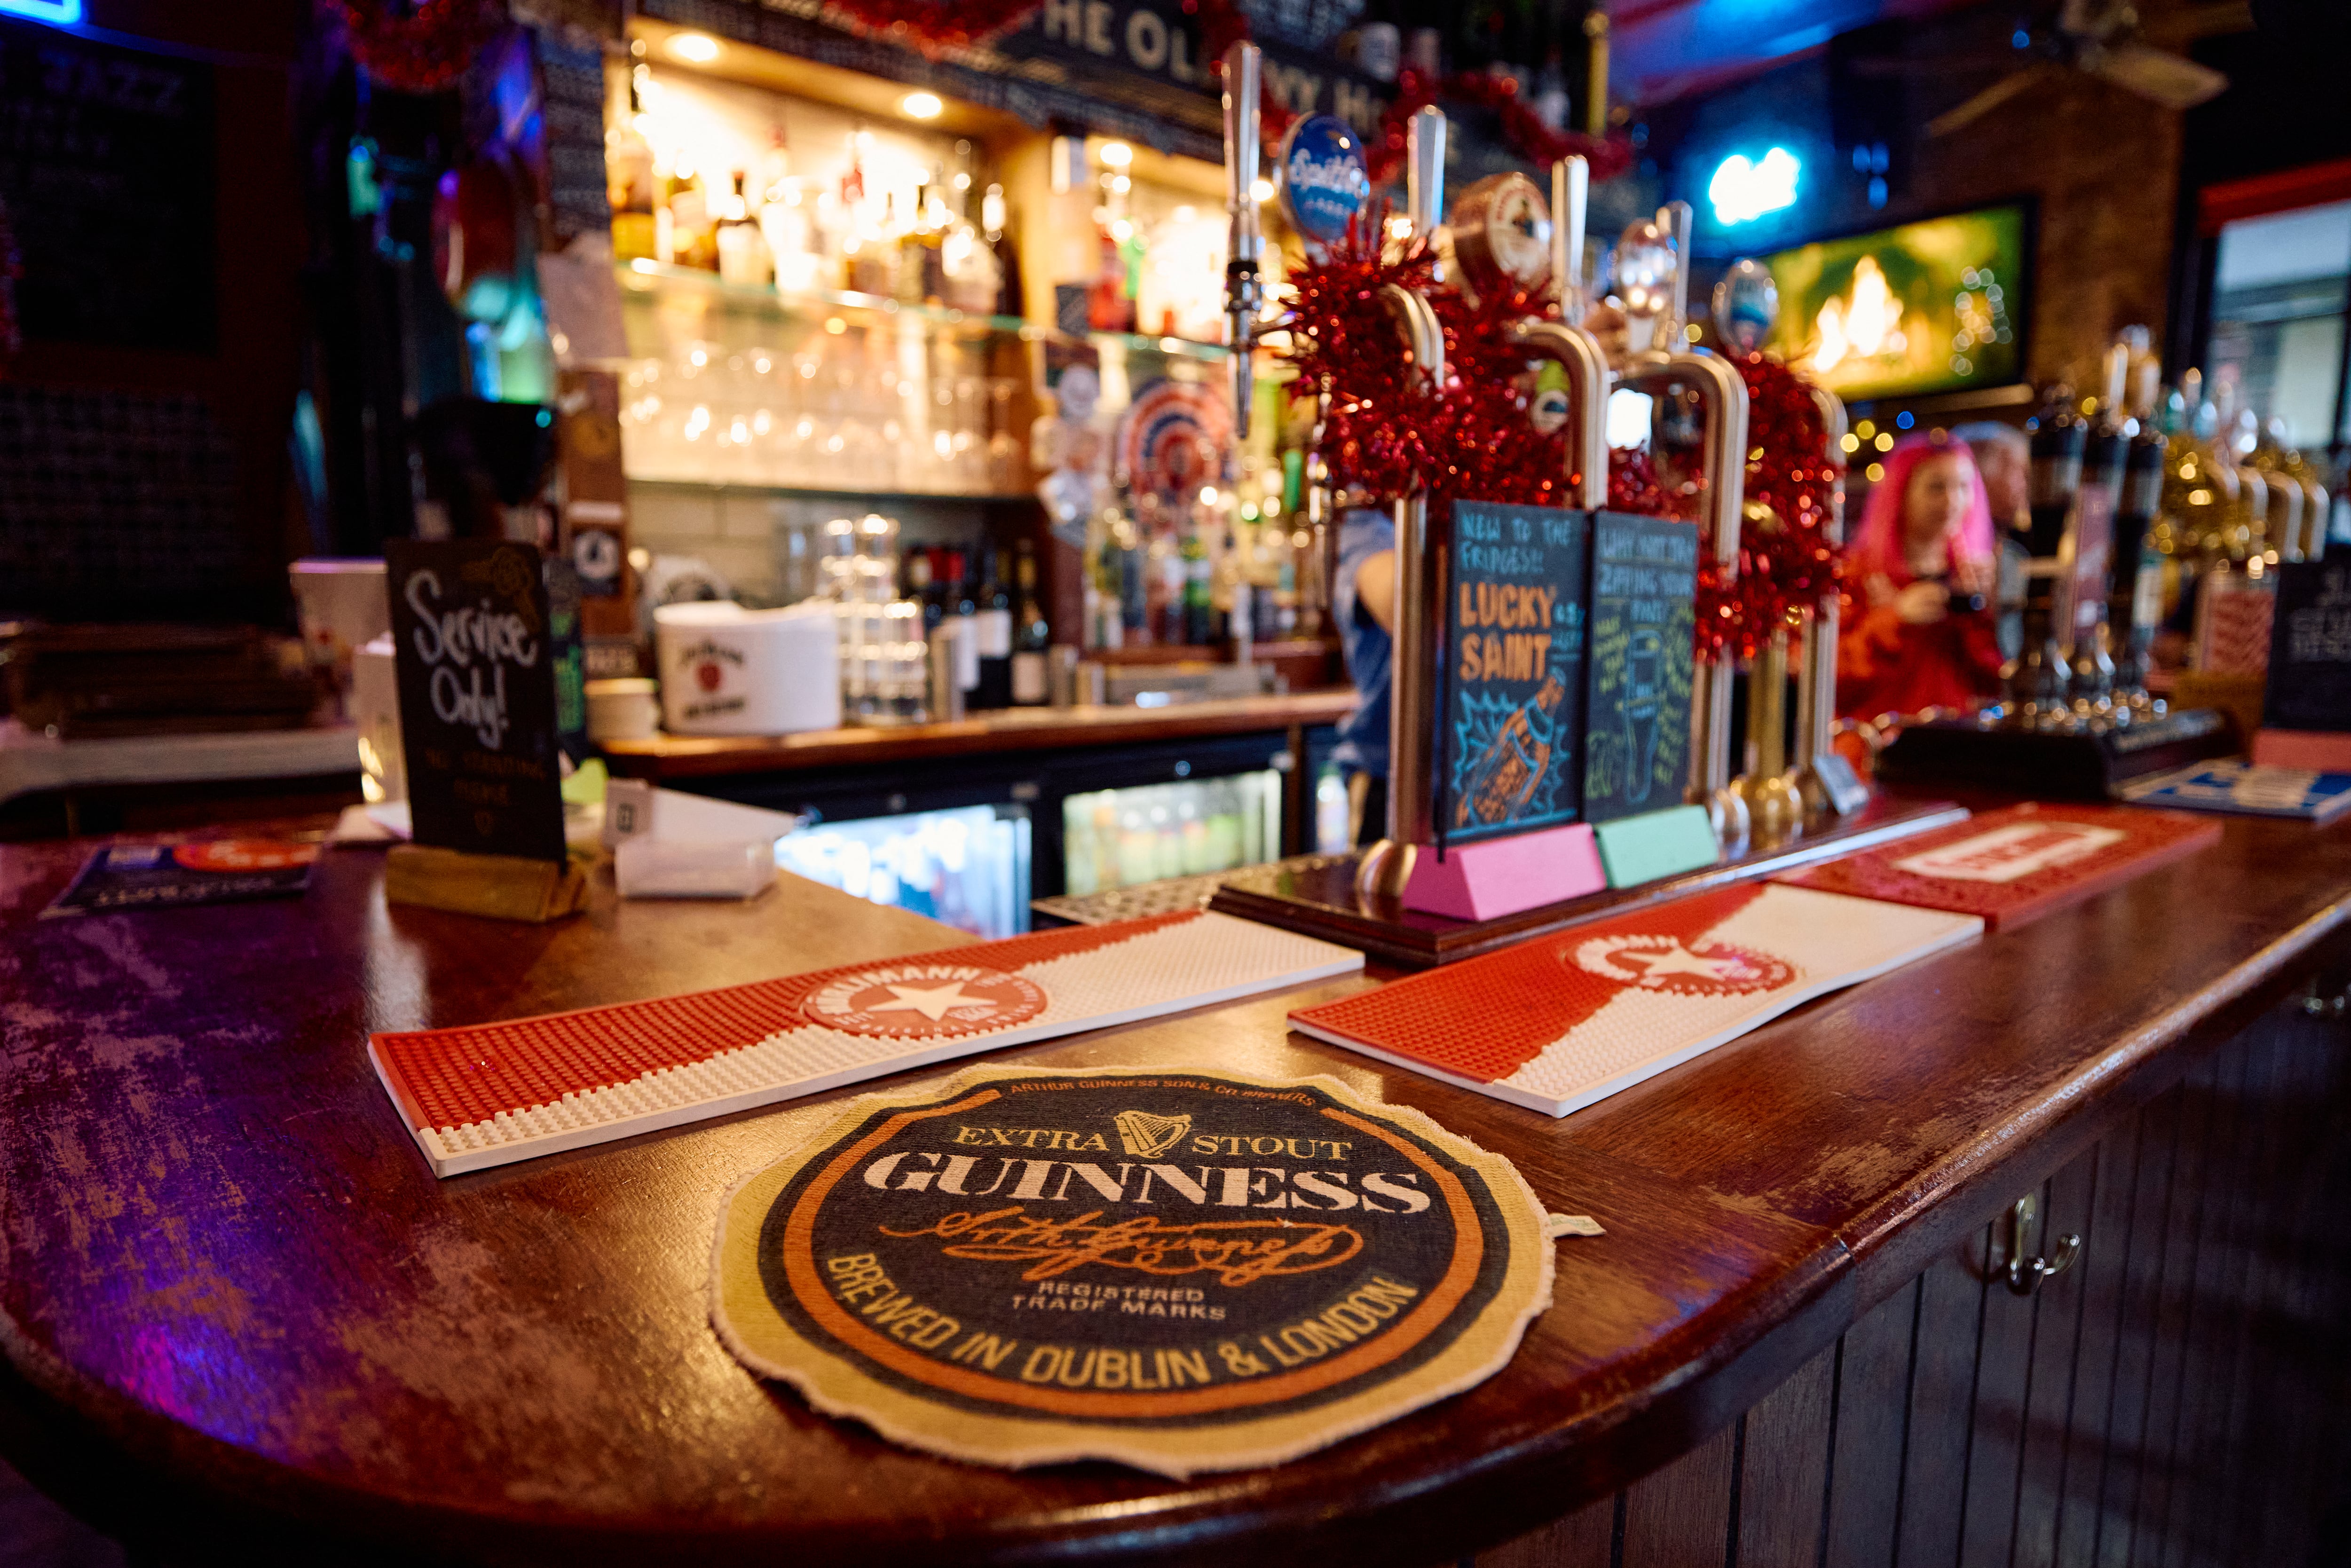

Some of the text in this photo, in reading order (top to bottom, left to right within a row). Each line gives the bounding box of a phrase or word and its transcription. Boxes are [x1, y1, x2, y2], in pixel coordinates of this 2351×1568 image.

[1041, 0, 1114, 55] HE
[1126, 9, 1213, 86] OL
[1460, 512, 1571, 546] NEW TO THE
[405, 567, 539, 667] Service
[1459, 581, 1558, 630] LUCKY
[1459, 632, 1552, 682] SAINT
[429, 663, 510, 749] Only!
[1011, 1082, 1075, 1094] ARTHUR
[1081, 1080, 1158, 1089] GUINNESS
[1162, 1080, 1194, 1088] SON
[1199, 1081, 1211, 1090] &
[1241, 1089, 1316, 1106] BREWERS
[955, 1126, 1353, 1161] EXTRA STOUT
[863, 1151, 1431, 1214] GUINNESS
[1011, 1294, 1226, 1320] TRADE MARKS
[1039, 1281, 1205, 1302] REGISTERED
[827, 1253, 1419, 1389] BREWED IN DUBLIN & LONDON
